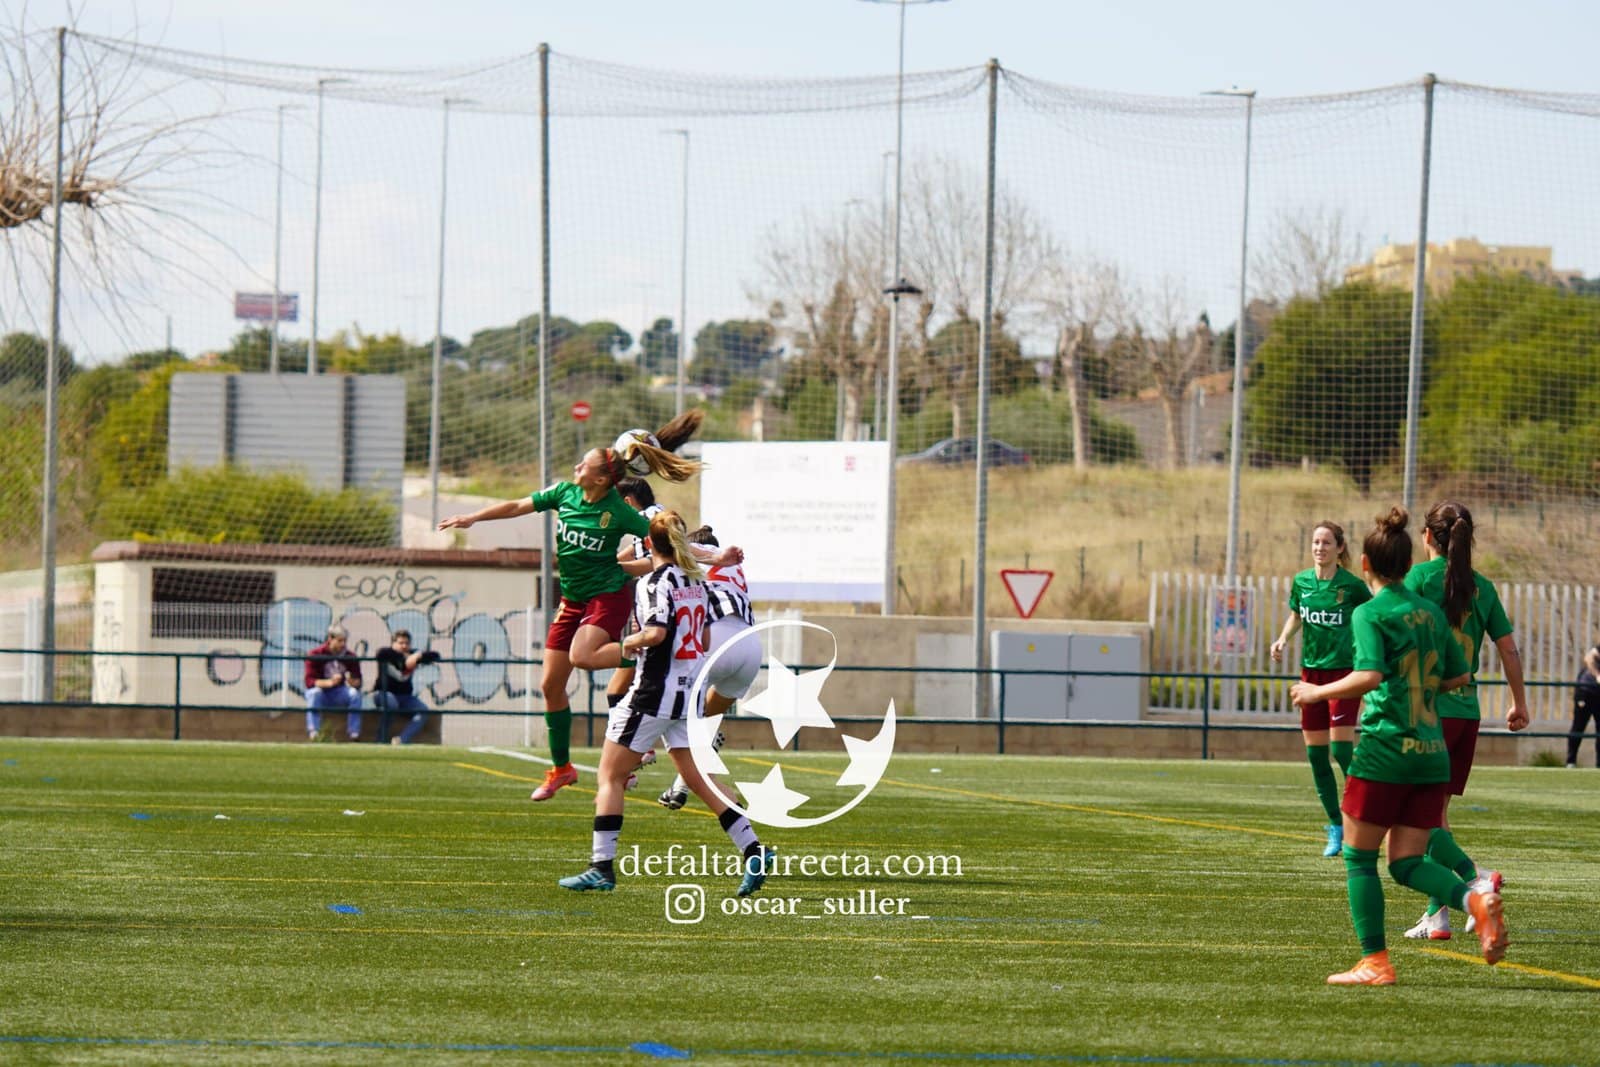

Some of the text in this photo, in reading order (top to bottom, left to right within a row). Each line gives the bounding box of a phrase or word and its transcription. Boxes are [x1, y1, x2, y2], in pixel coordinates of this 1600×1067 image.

[675, 604, 706, 660] 20
[1400, 650, 1441, 729] 16
[1402, 737, 1447, 754] PULEV
